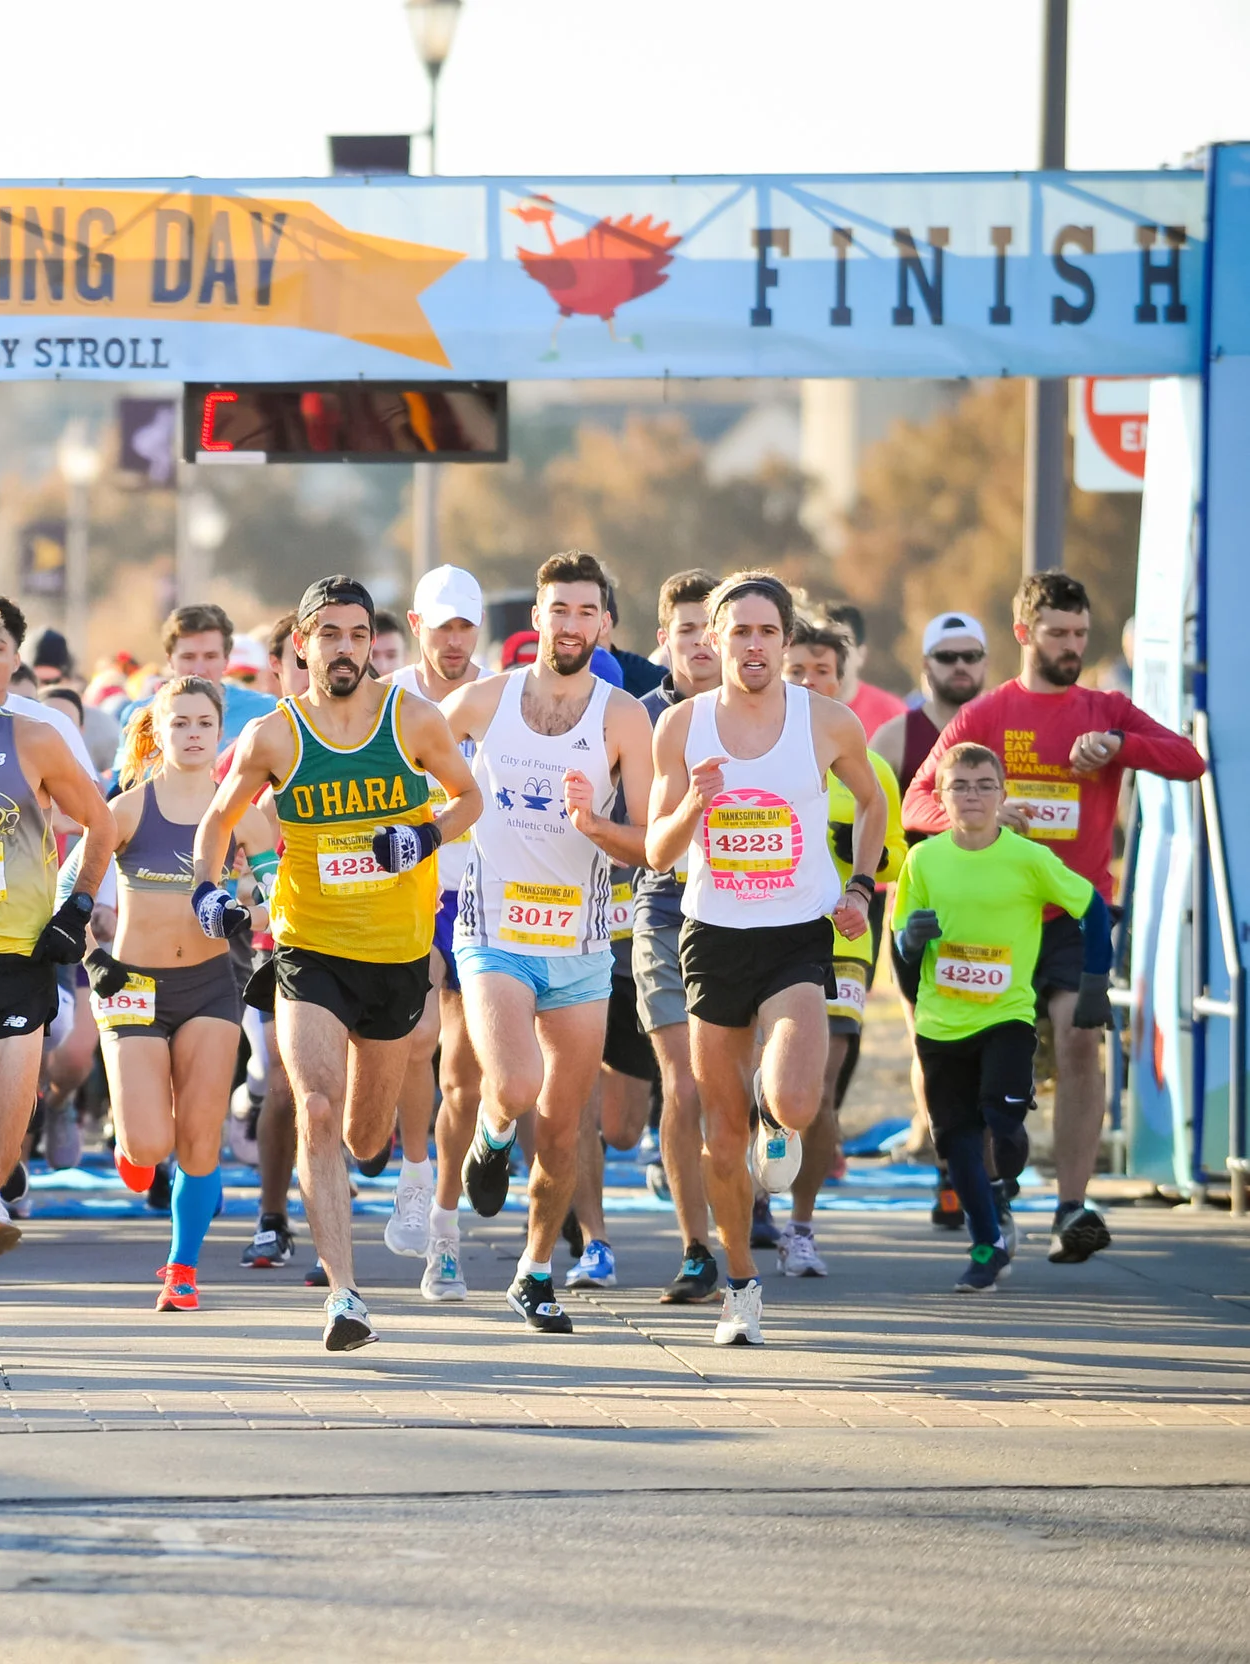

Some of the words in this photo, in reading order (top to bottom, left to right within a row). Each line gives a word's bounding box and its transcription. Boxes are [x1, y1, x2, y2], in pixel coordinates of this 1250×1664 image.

[152, 208, 290, 306] DAY
[750, 224, 1188, 326] FINISH
[35, 338, 169, 370] STROLL
[1004, 729, 1035, 740] RUN
[1004, 740, 1031, 752] EAT
[500, 754, 520, 767] City
[521, 758, 532, 767] of
[533, 760, 569, 774] Founta
[1004, 752, 1038, 763] GIVE
[291, 775, 408, 818] O'HARA
[718, 811, 765, 821] THANKSGIVING
[768, 810, 780, 820] DAY
[506, 818, 542, 831] Athletic
[543, 823, 565, 835] Club
[715, 833, 783, 853] 4223
[516, 884, 561, 897] THANKSGIVING
[562, 889, 575, 899] DAY
[508, 905, 573, 928] 3017
[941, 965, 1003, 986] 4220
